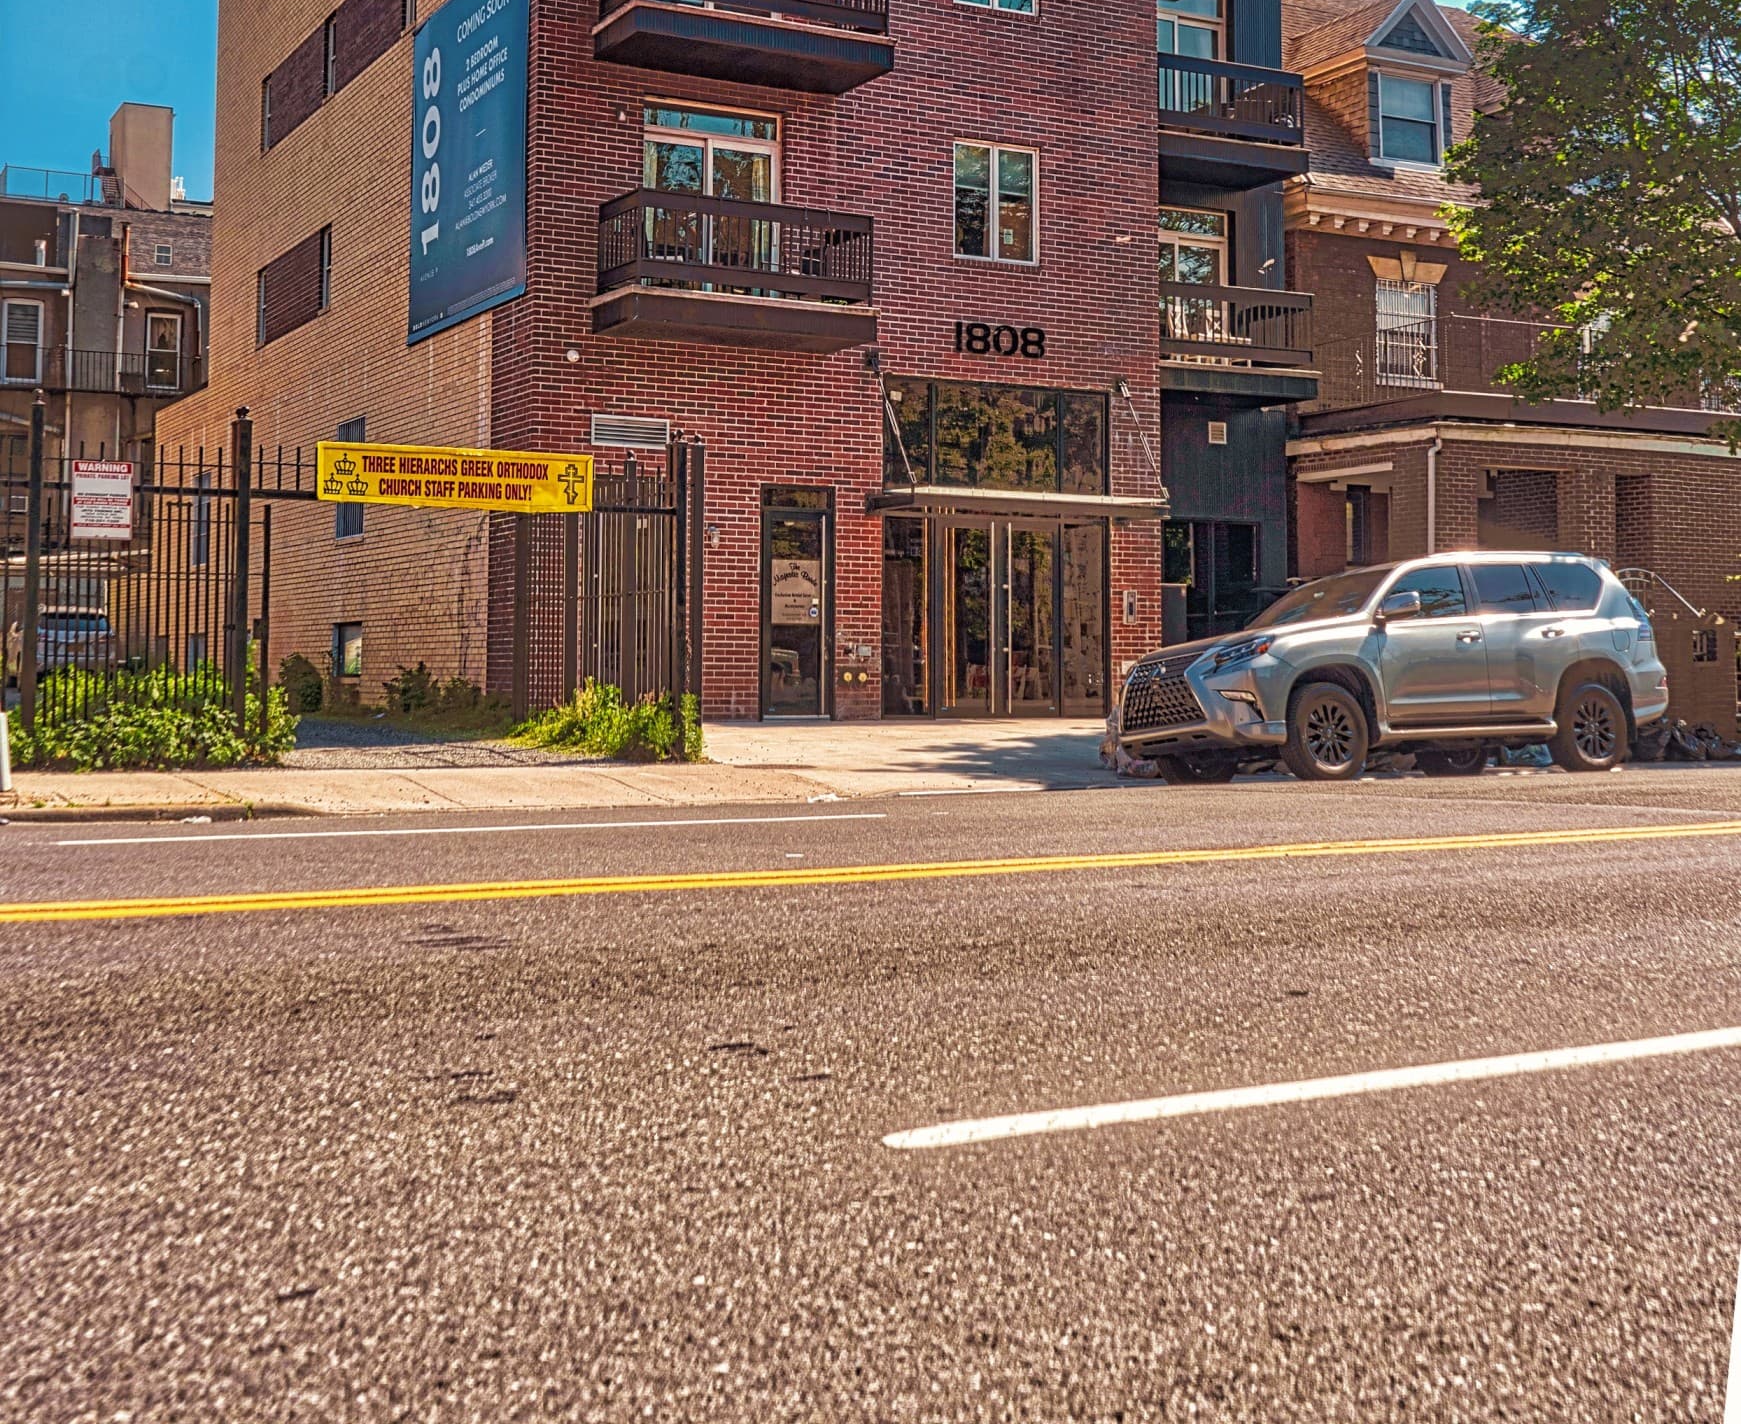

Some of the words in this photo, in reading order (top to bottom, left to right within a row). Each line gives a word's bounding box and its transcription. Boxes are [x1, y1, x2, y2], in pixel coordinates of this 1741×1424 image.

[457, 5, 485, 43] COMING
[470, 35, 499, 68] BEDROOM
[457, 76, 470, 97] PLUS
[471, 62, 487, 86] HOME
[488, 47, 508, 72] OFFICE
[459, 68, 505, 113] CONDOMINIUMS
[421, 47, 441, 256] 1808
[955, 321, 1045, 359] 1808
[77, 462, 128, 473] WARNING
[362, 456, 396, 473] THREE
[399, 457, 458, 476] HIERARCHS
[461, 460, 494, 478] GREEK
[497, 461, 549, 481] ORTHODOX
[379, 478, 422, 496] CHURCH
[424, 479, 455, 498] STAFF
[458, 481, 502, 500] PARKING
[505, 483, 532, 501] ONLY!
